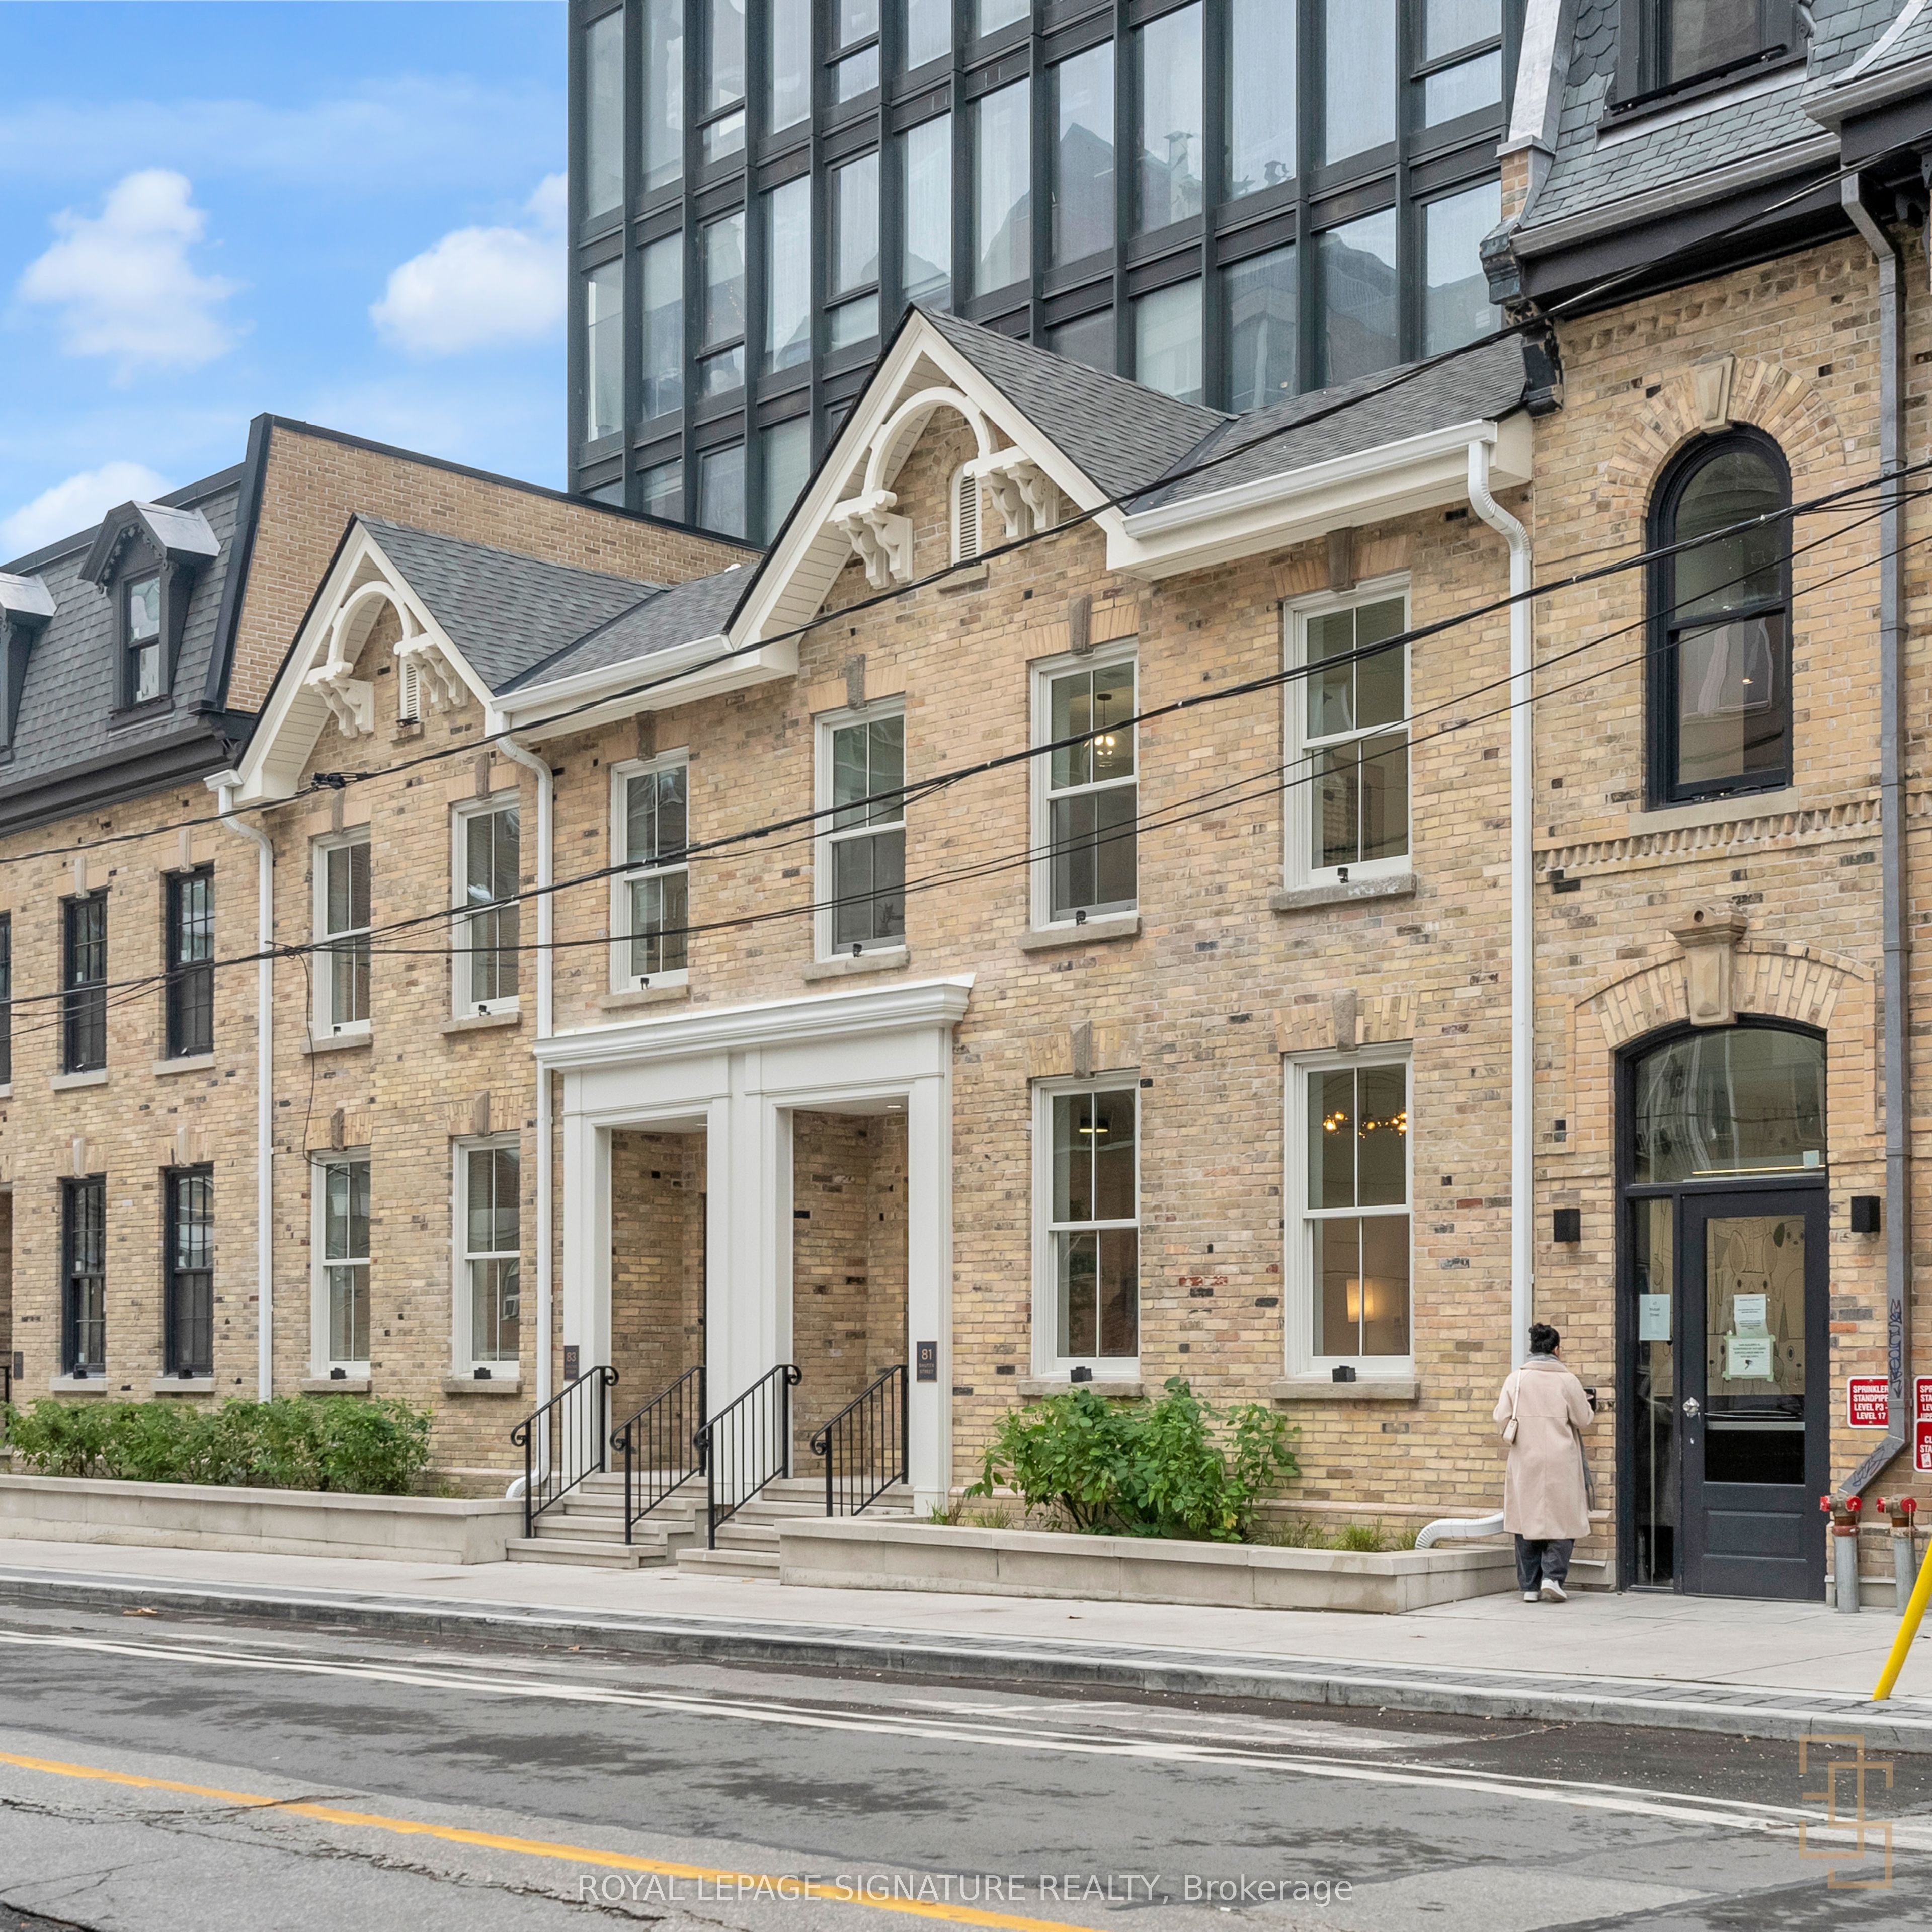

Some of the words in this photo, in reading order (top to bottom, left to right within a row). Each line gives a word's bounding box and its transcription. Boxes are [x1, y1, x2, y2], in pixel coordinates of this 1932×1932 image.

[567, 1352, 576, 1362] 83
[921, 1349, 932, 1360] 81
[1853, 1385, 1888, 1393] SPRINKLER
[1853, 1394, 1888, 1402] STANDPIPE
[1854, 1403, 1874, 1411] LEVEL
[1875, 1403, 1884, 1411] P3
[1857, 1412, 1877, 1420] LEVEL
[1878, 1412, 1886, 1420] 17
